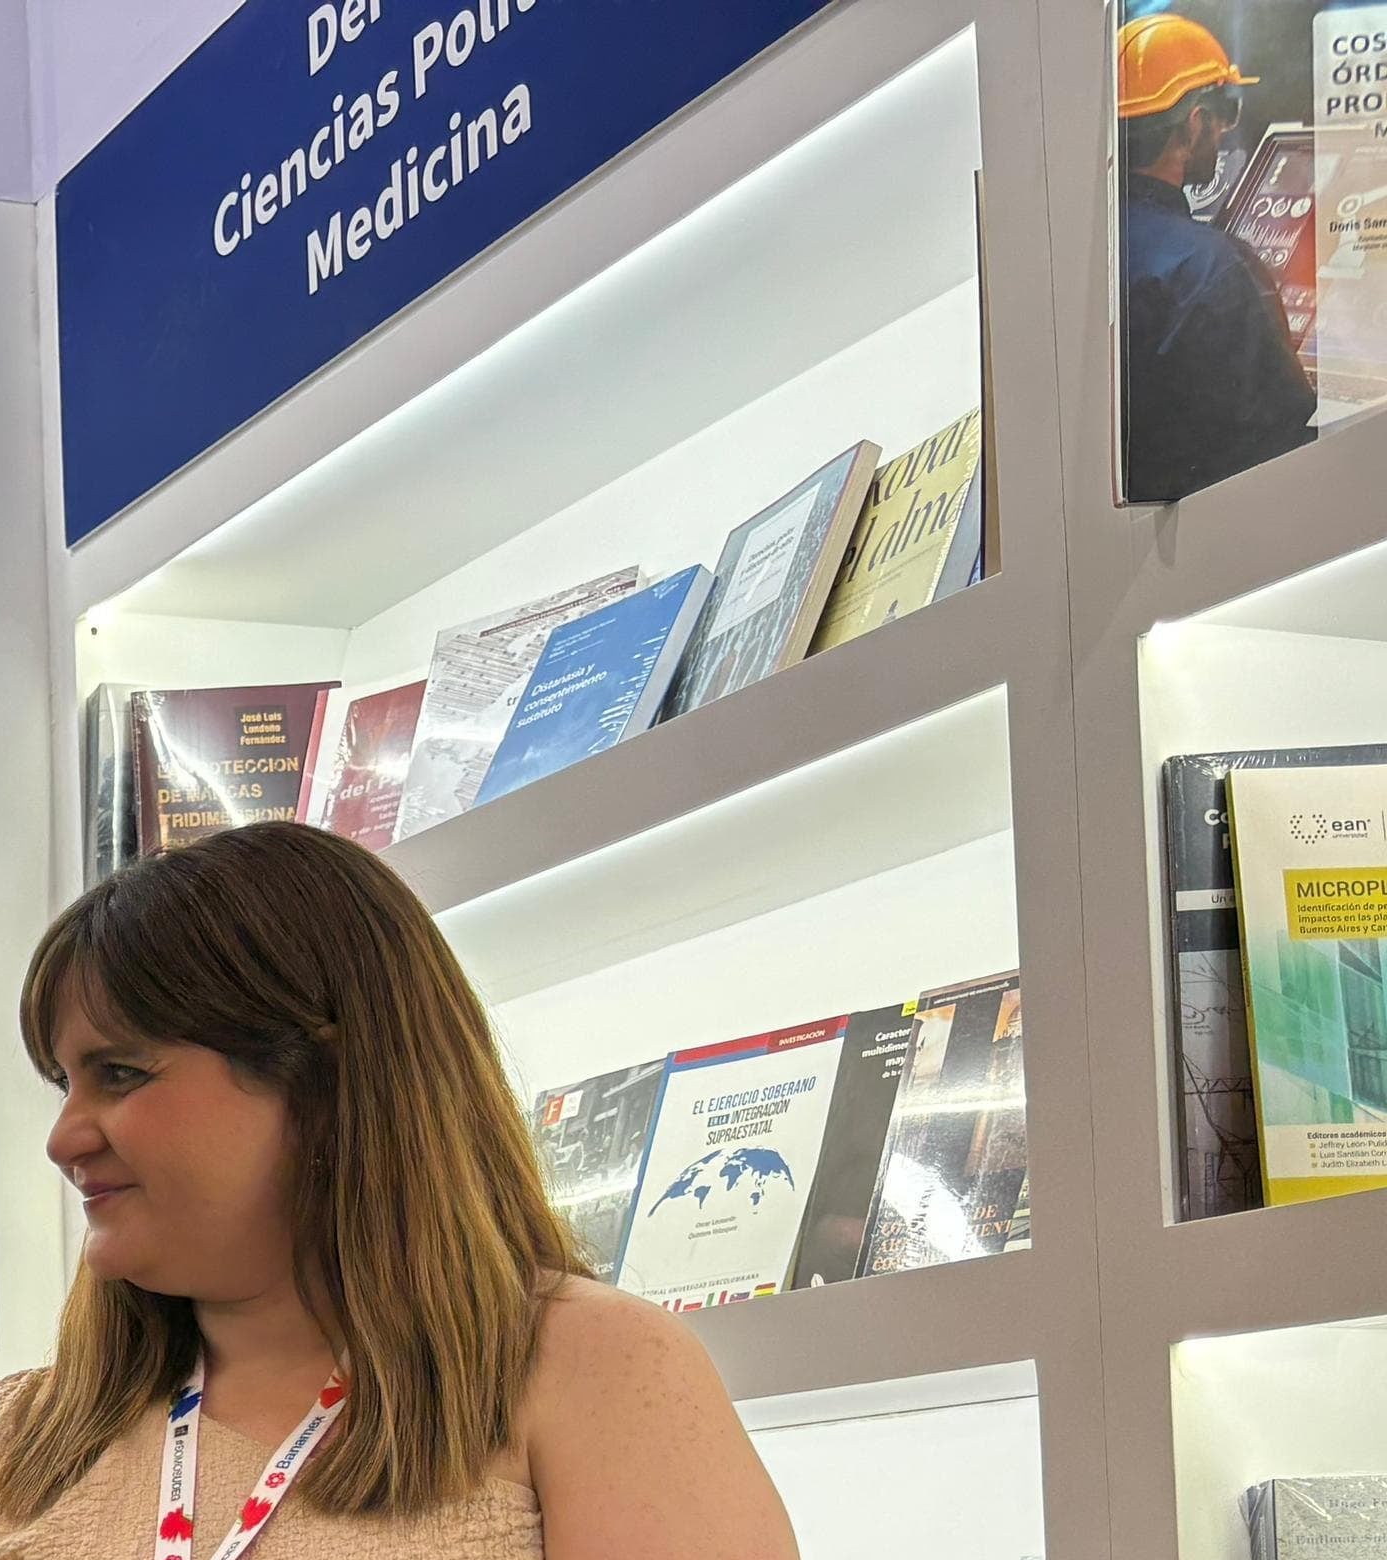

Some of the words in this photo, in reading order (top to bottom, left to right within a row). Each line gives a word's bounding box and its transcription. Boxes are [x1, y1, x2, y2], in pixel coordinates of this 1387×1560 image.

[213, 68, 400, 257] Ciencias
[306, 83, 533, 295] Medicina
[1329, 219, 1360, 233] Doris
[524, 671, 607, 712] consentimiento
[240, 713, 261, 723] José
[264, 712, 282, 721] Luis
[516, 702, 562, 728] sustituto
[244, 724, 281, 734] Londoño
[240, 735, 286, 745] Fernández
[187, 784, 263, 802] MACAS
[1332, 819, 1367, 832] ean
[1298, 902, 1360, 913] Identificación
[1363, 902, 1375, 911] de
[1299, 914, 1342, 924] impactos
[1358, 913, 1371, 921] las
[1300, 926, 1335, 934] Buenos
[1336, 925, 1361, 933] Aires
[1363, 925, 1369, 934] y
[693, 1100, 704, 1115] EL
[708, 1089, 759, 1113] EJERCICIO
[761, 1076, 816, 1102] SOBERANO
[731, 1096, 790, 1124] INTEGRACIÓN
[706, 1119, 773, 1145] SUPRAESTATAL
[276, 1416, 326, 1470] Banamex
